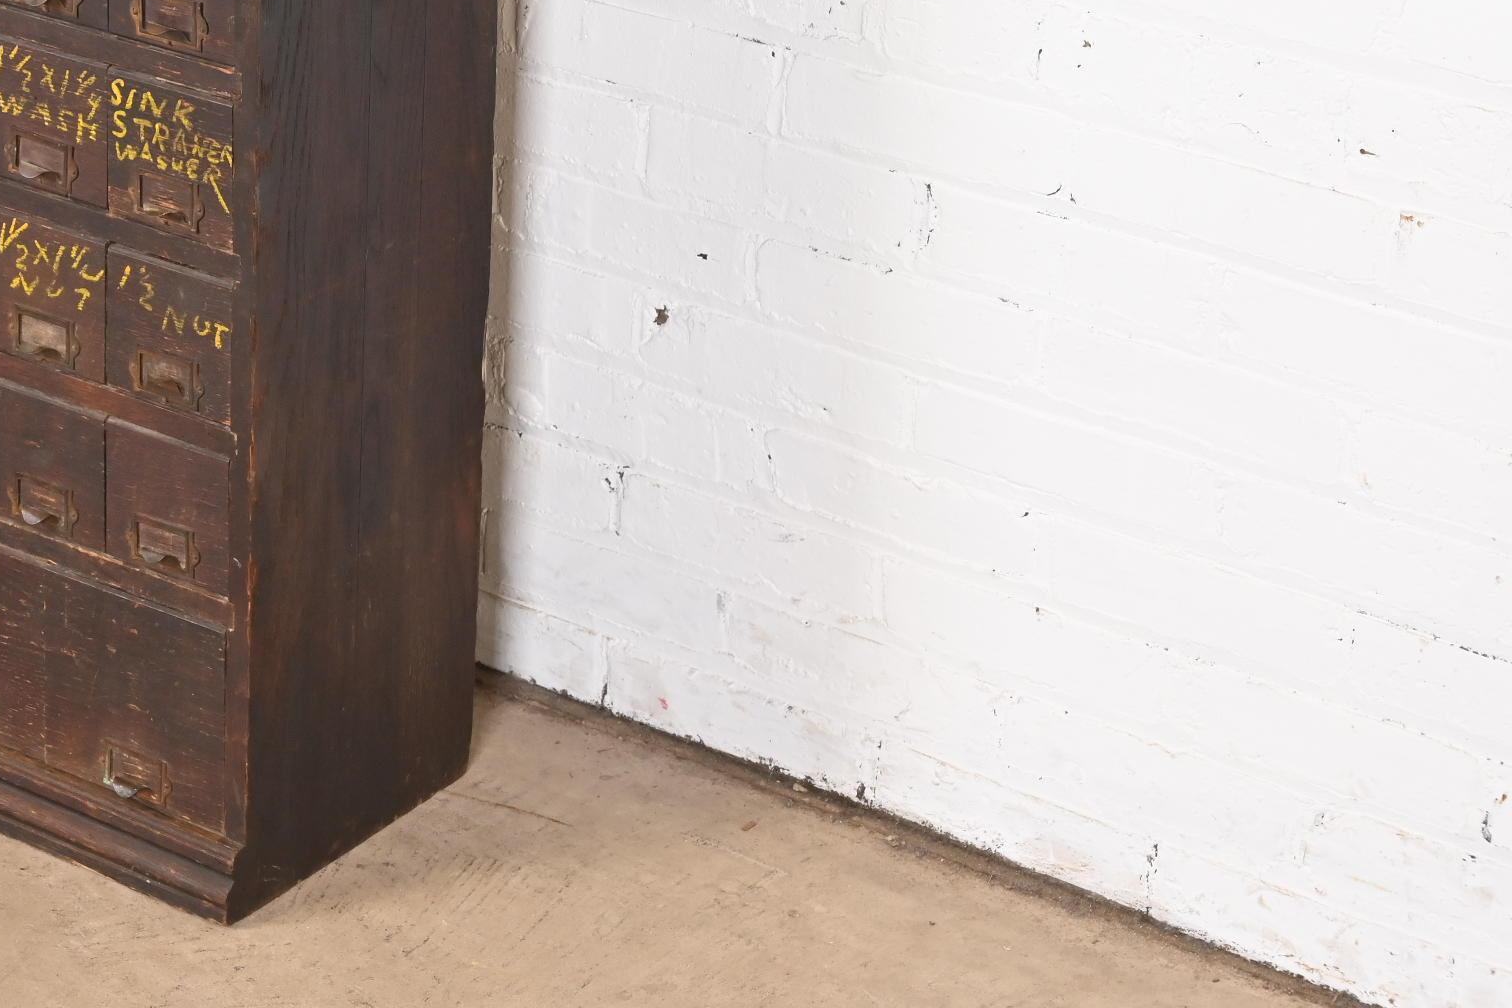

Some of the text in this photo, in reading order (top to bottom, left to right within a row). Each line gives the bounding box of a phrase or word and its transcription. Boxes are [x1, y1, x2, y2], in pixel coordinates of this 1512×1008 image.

[110, 78, 196, 131] SINK
[9, 272, 91, 311] NUT
[161, 303, 232, 350] NUT
